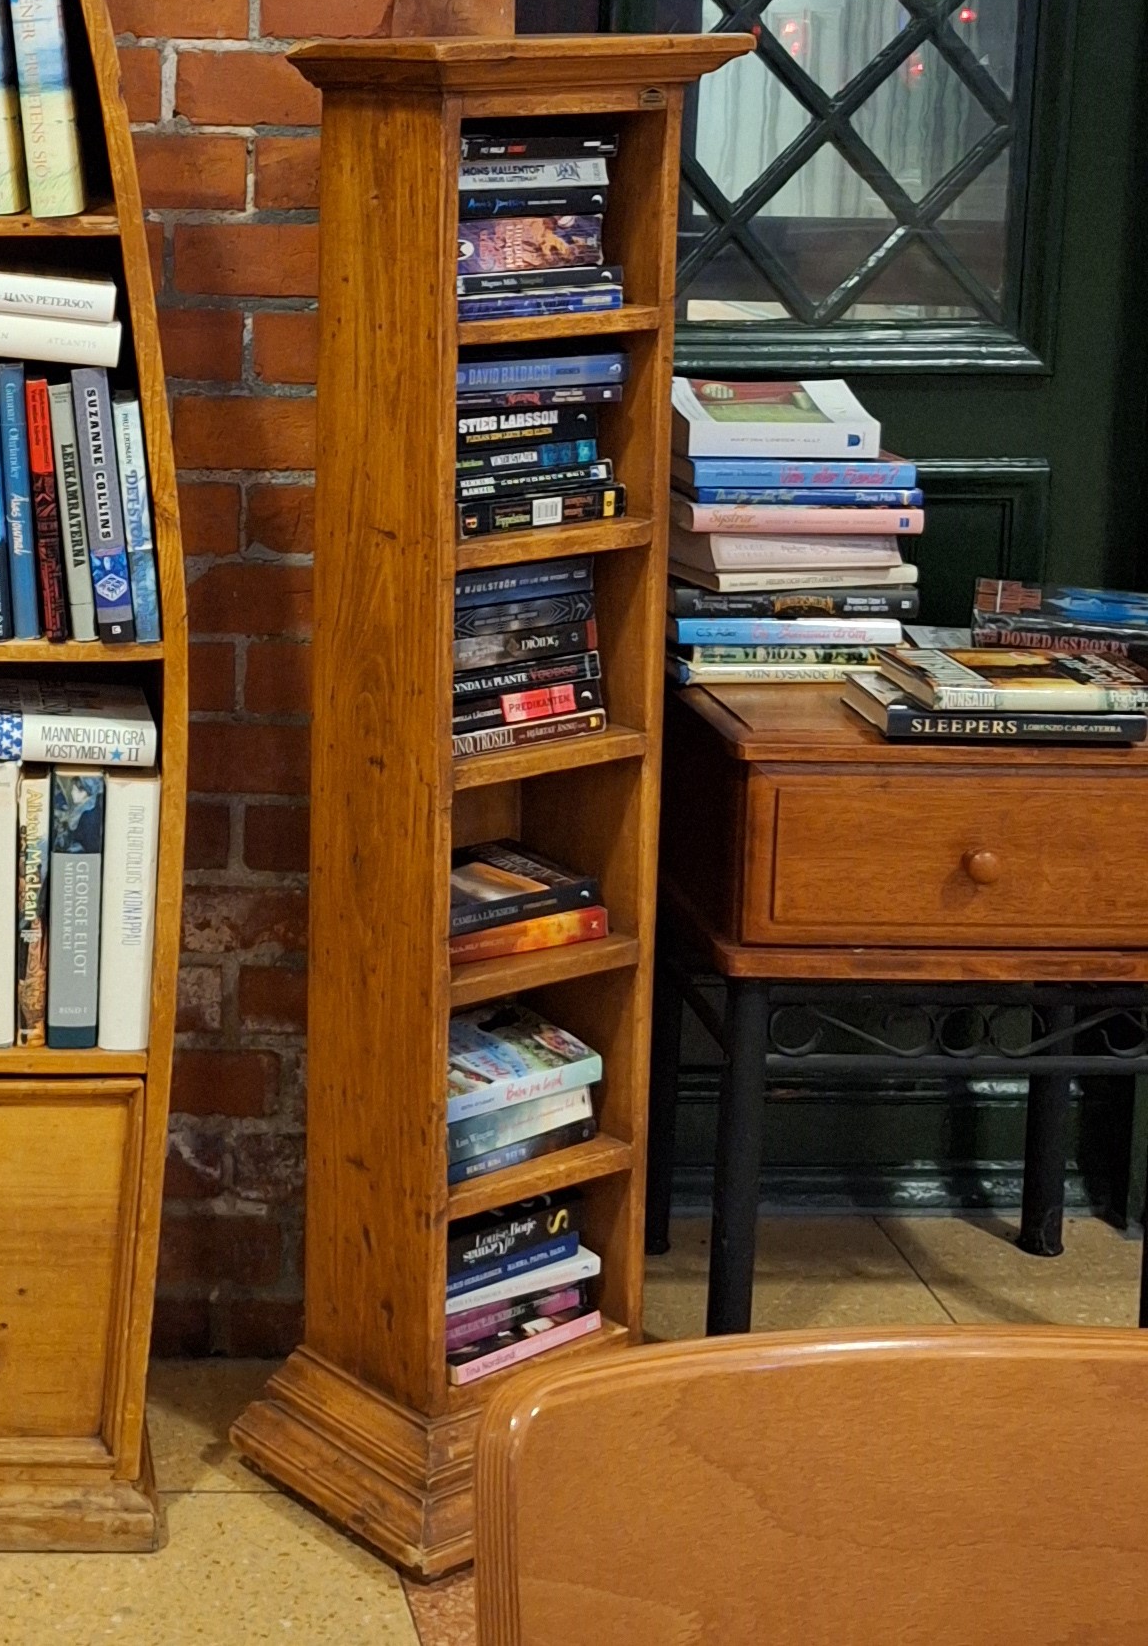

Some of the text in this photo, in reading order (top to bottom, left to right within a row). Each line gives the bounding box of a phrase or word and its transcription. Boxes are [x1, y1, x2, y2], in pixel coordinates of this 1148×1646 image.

[36, 294, 94, 309] PETERSON
[469, 368, 499, 385] DAVID
[459, 410, 558, 433] STIEG LARSSON
[86, 387, 112, 540] SUZANNE COLLINS
[61, 443, 86, 568] LEKKAMRATERNA
[1001, 631, 1129, 657] DOMEDAGSBOKEN
[494, 673, 528, 686] PLANTE
[509, 695, 571, 713] PREDIKANTEN
[41, 726, 146, 746] MANNEN DEN GRÅ
[911, 718, 1018, 734] SLEEPERS
[45, 746, 106, 760] KOSTYMEN
[24, 789, 43, 921] Alistair MacLean
[62, 862, 74, 950] MIDDLEMARCH
[73, 862, 89, 977] GEORGE ELIOT
[122, 890, 143, 946] KIDNAPPAD
